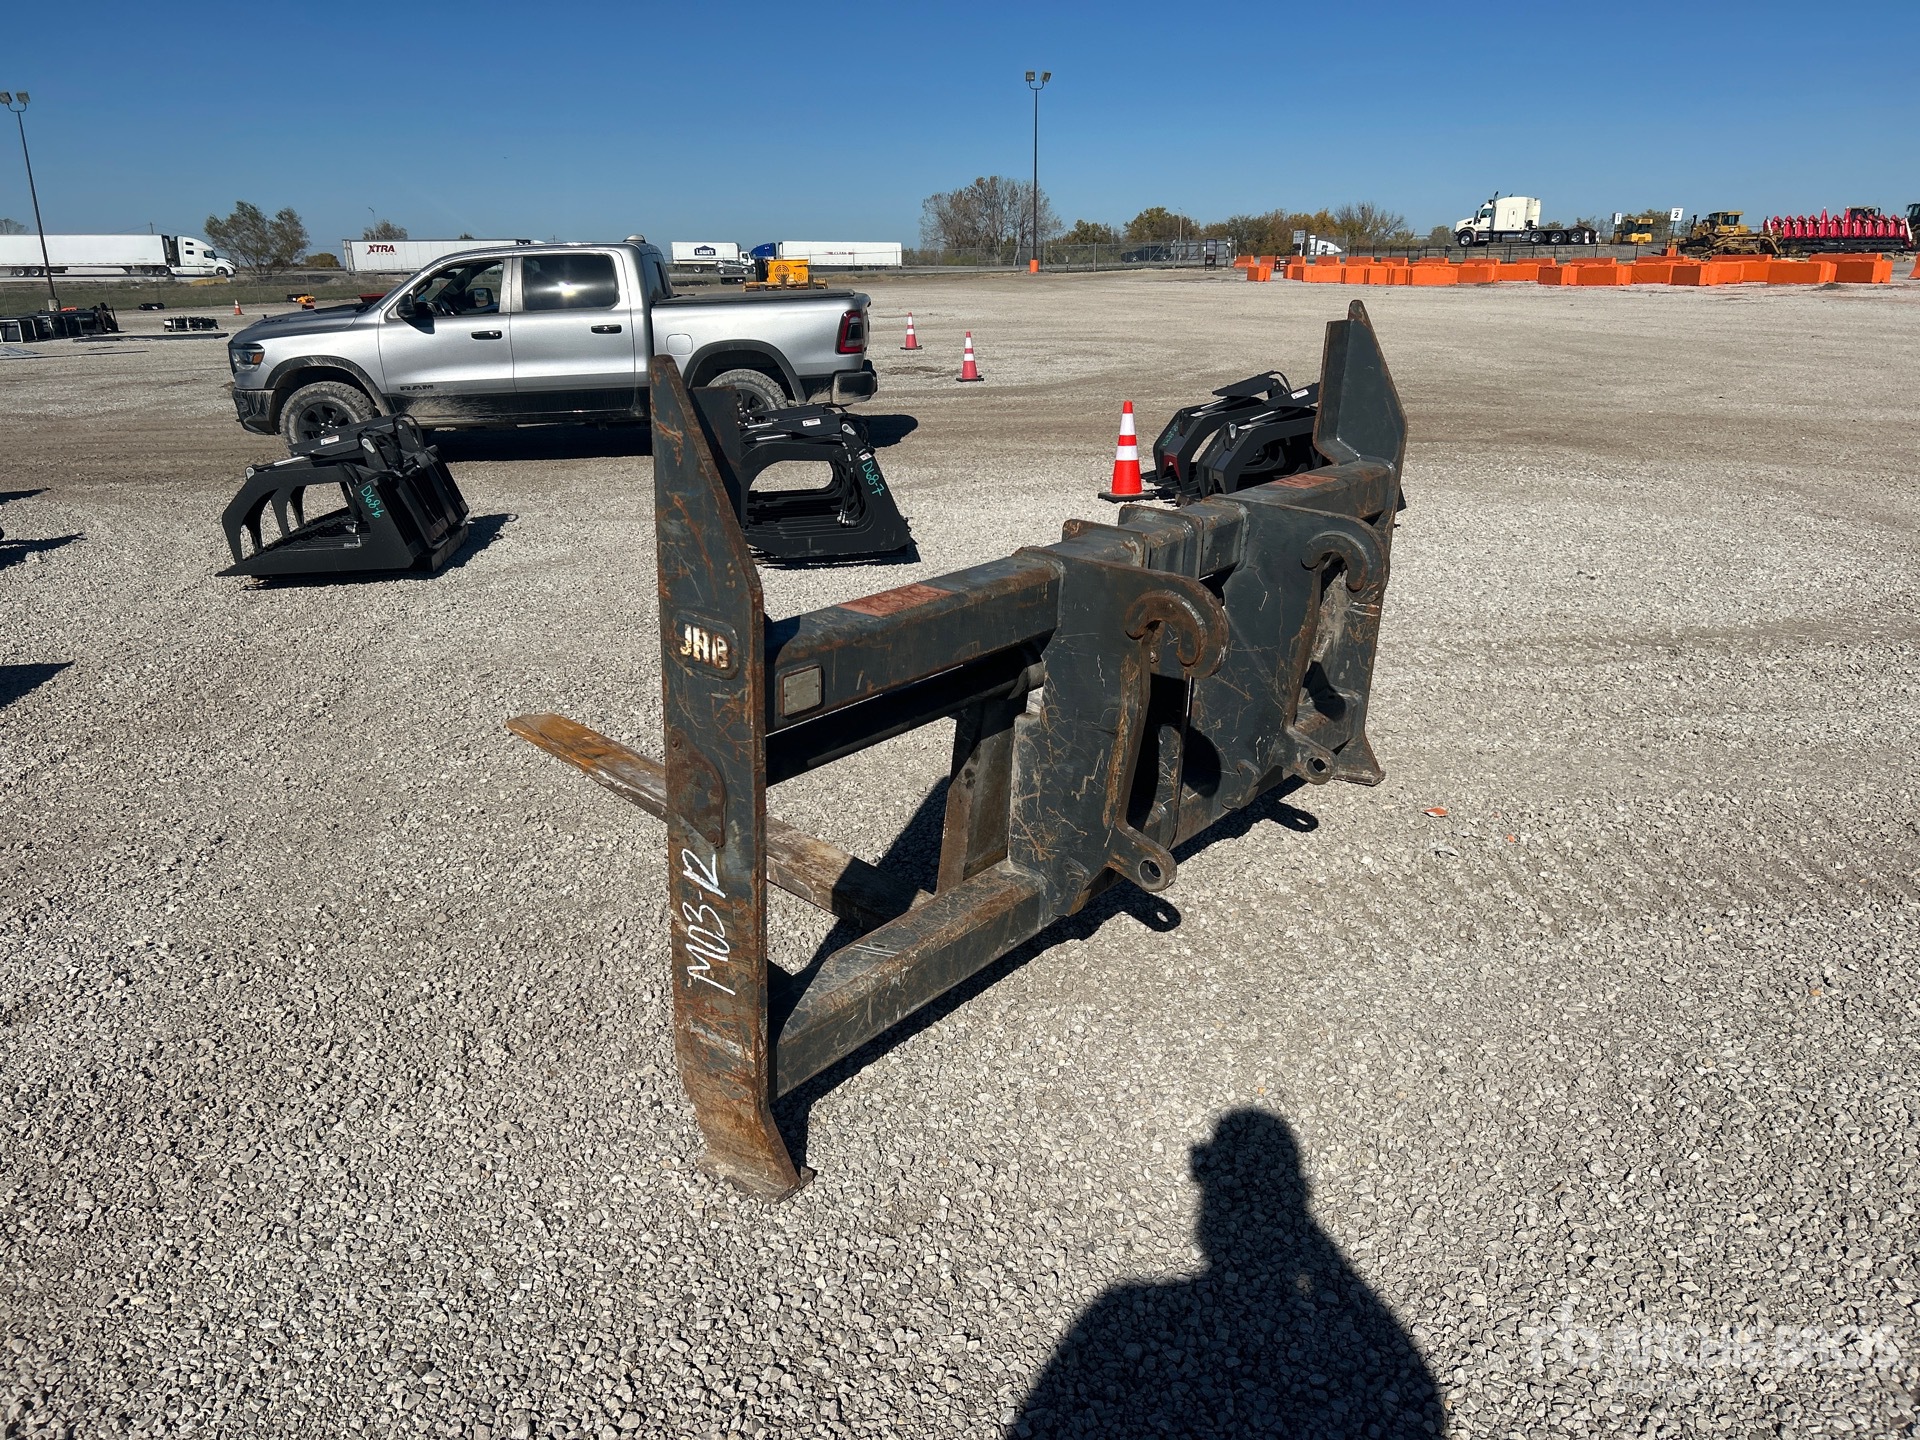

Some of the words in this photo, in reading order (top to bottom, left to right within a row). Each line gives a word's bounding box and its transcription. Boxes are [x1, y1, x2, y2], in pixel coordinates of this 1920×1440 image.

[1673, 211, 1680, 219] 2
[367, 244, 396, 255] XTRA
[861, 460, 885, 497] D68-7
